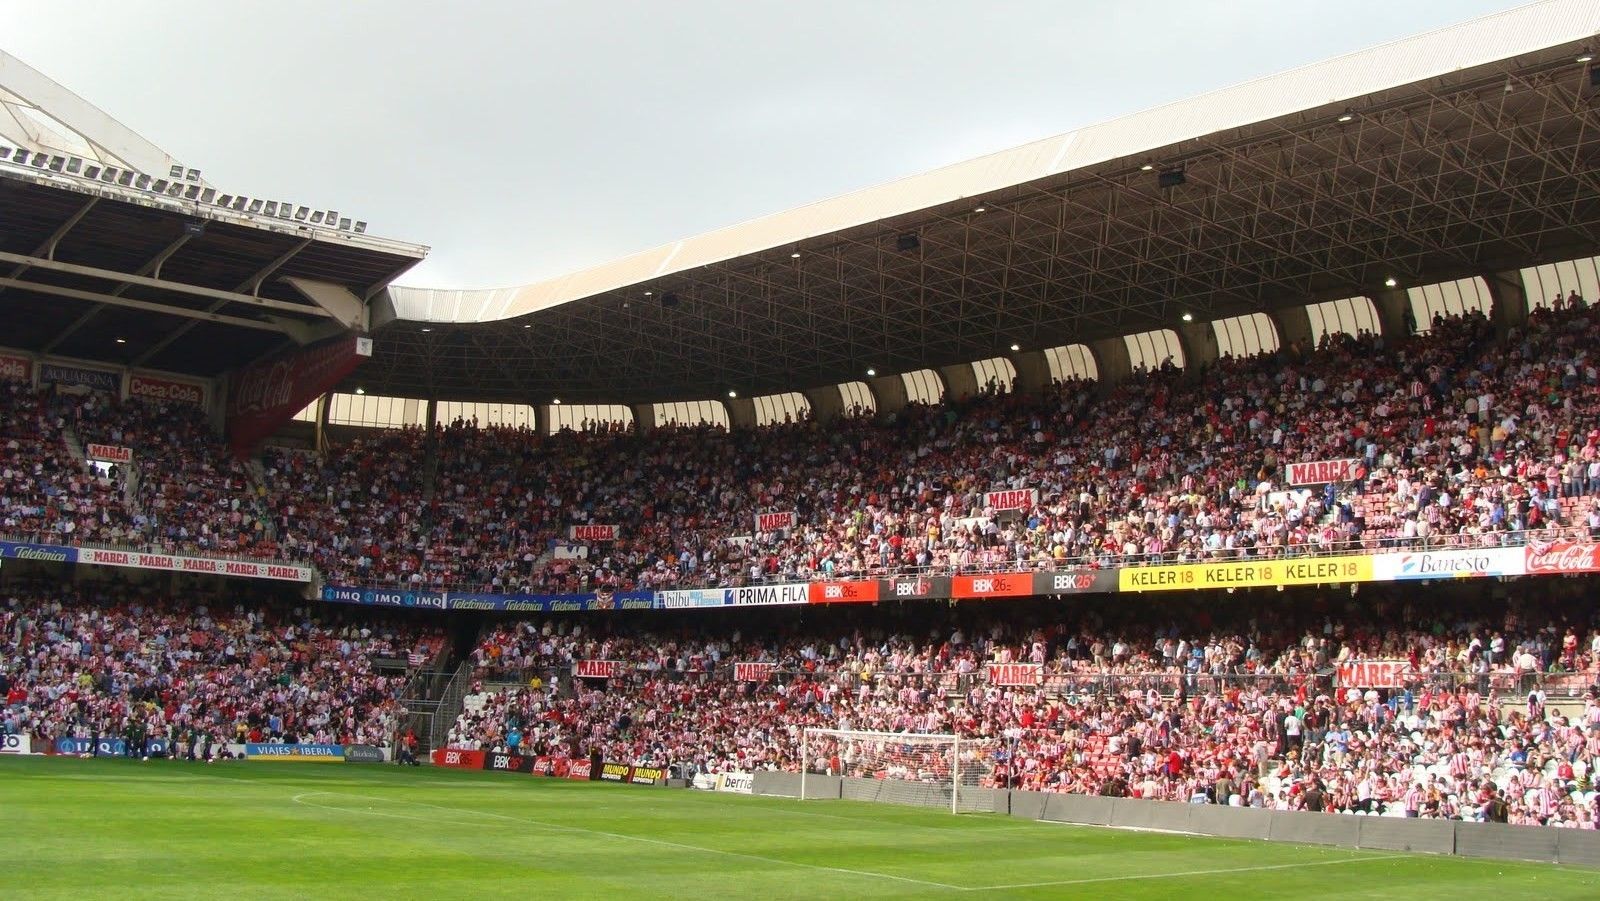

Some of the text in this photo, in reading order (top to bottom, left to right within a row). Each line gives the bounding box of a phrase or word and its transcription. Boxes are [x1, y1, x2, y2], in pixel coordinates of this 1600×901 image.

[92, 446, 129, 460] MARCA
[1292, 460, 1351, 484] MARCA
[989, 490, 1032, 509] MARCA
[575, 526, 613, 539] MARCA
[94, 551, 299, 579] MARCA MARCA MARCA MARCA MARCA
[1420, 554, 1489, 573] Banesto
[1131, 563, 1357, 585] KELER 18 KELER 18 KELER 18
[335, 591, 442, 607] IMQ IMQ IMQ
[739, 588, 777, 604] PRIMA
[782, 585, 807, 602] FILA
[989, 665, 1036, 683] MARCA
[1337, 663, 1404, 686] MARCA
[257, 746, 333, 756] VIAJES IBERIA
[603, 764, 629, 776] MUNDO
[634, 768, 662, 779] MUNDO
[725, 775, 752, 790] berria
